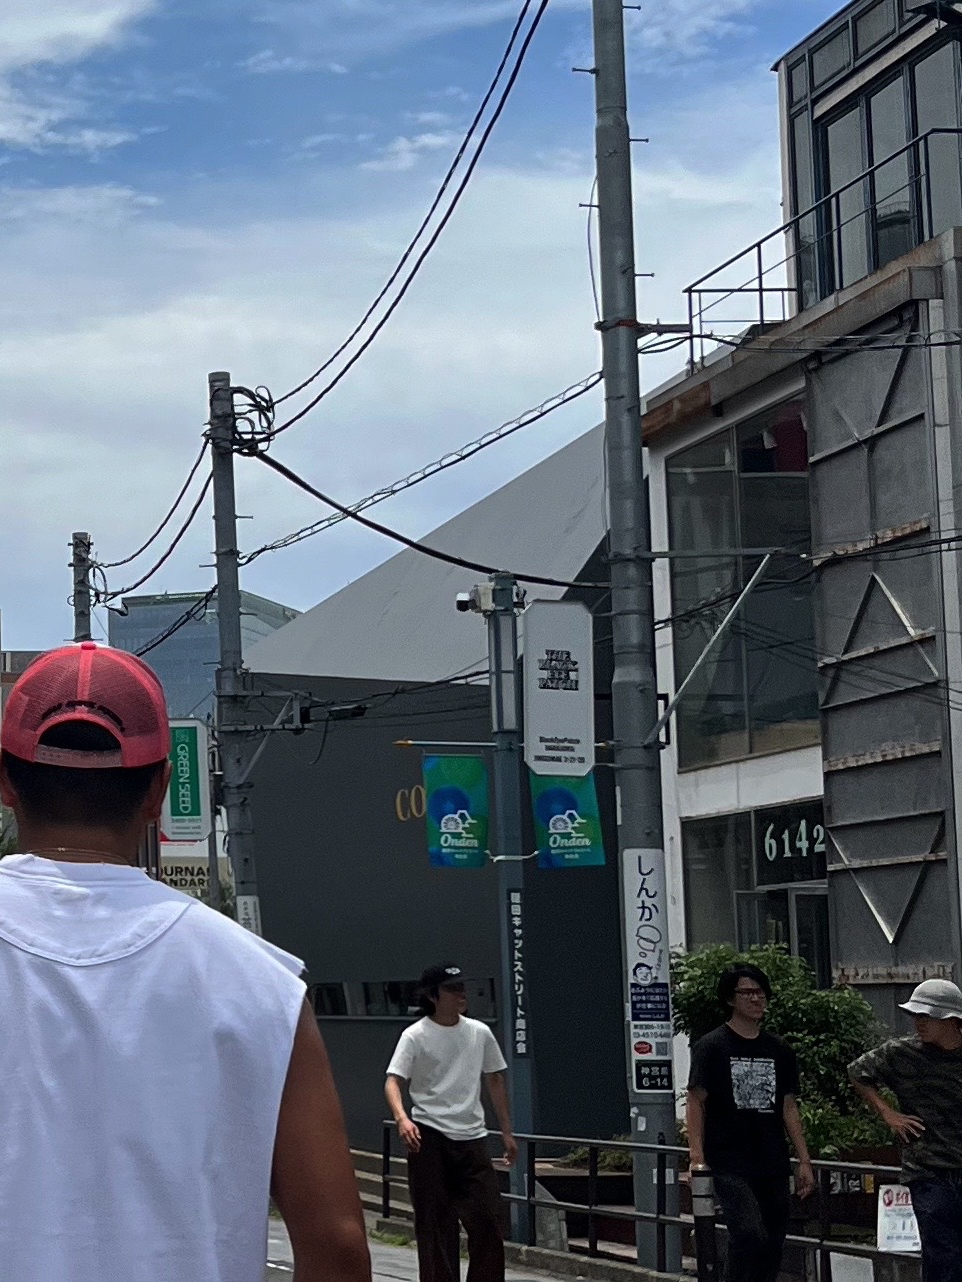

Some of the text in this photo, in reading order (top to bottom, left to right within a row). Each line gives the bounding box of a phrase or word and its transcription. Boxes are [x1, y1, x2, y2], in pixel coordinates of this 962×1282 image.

[176, 743, 190, 783] GREEN
[178, 784, 192, 814] SEED
[440, 833, 479, 847] Onden
[549, 834, 592, 848] Onden
[764, 818, 826, 861] 6142
[636, 855, 659, 922] しんか
[642, 1077, 669, 1087] 6-14
